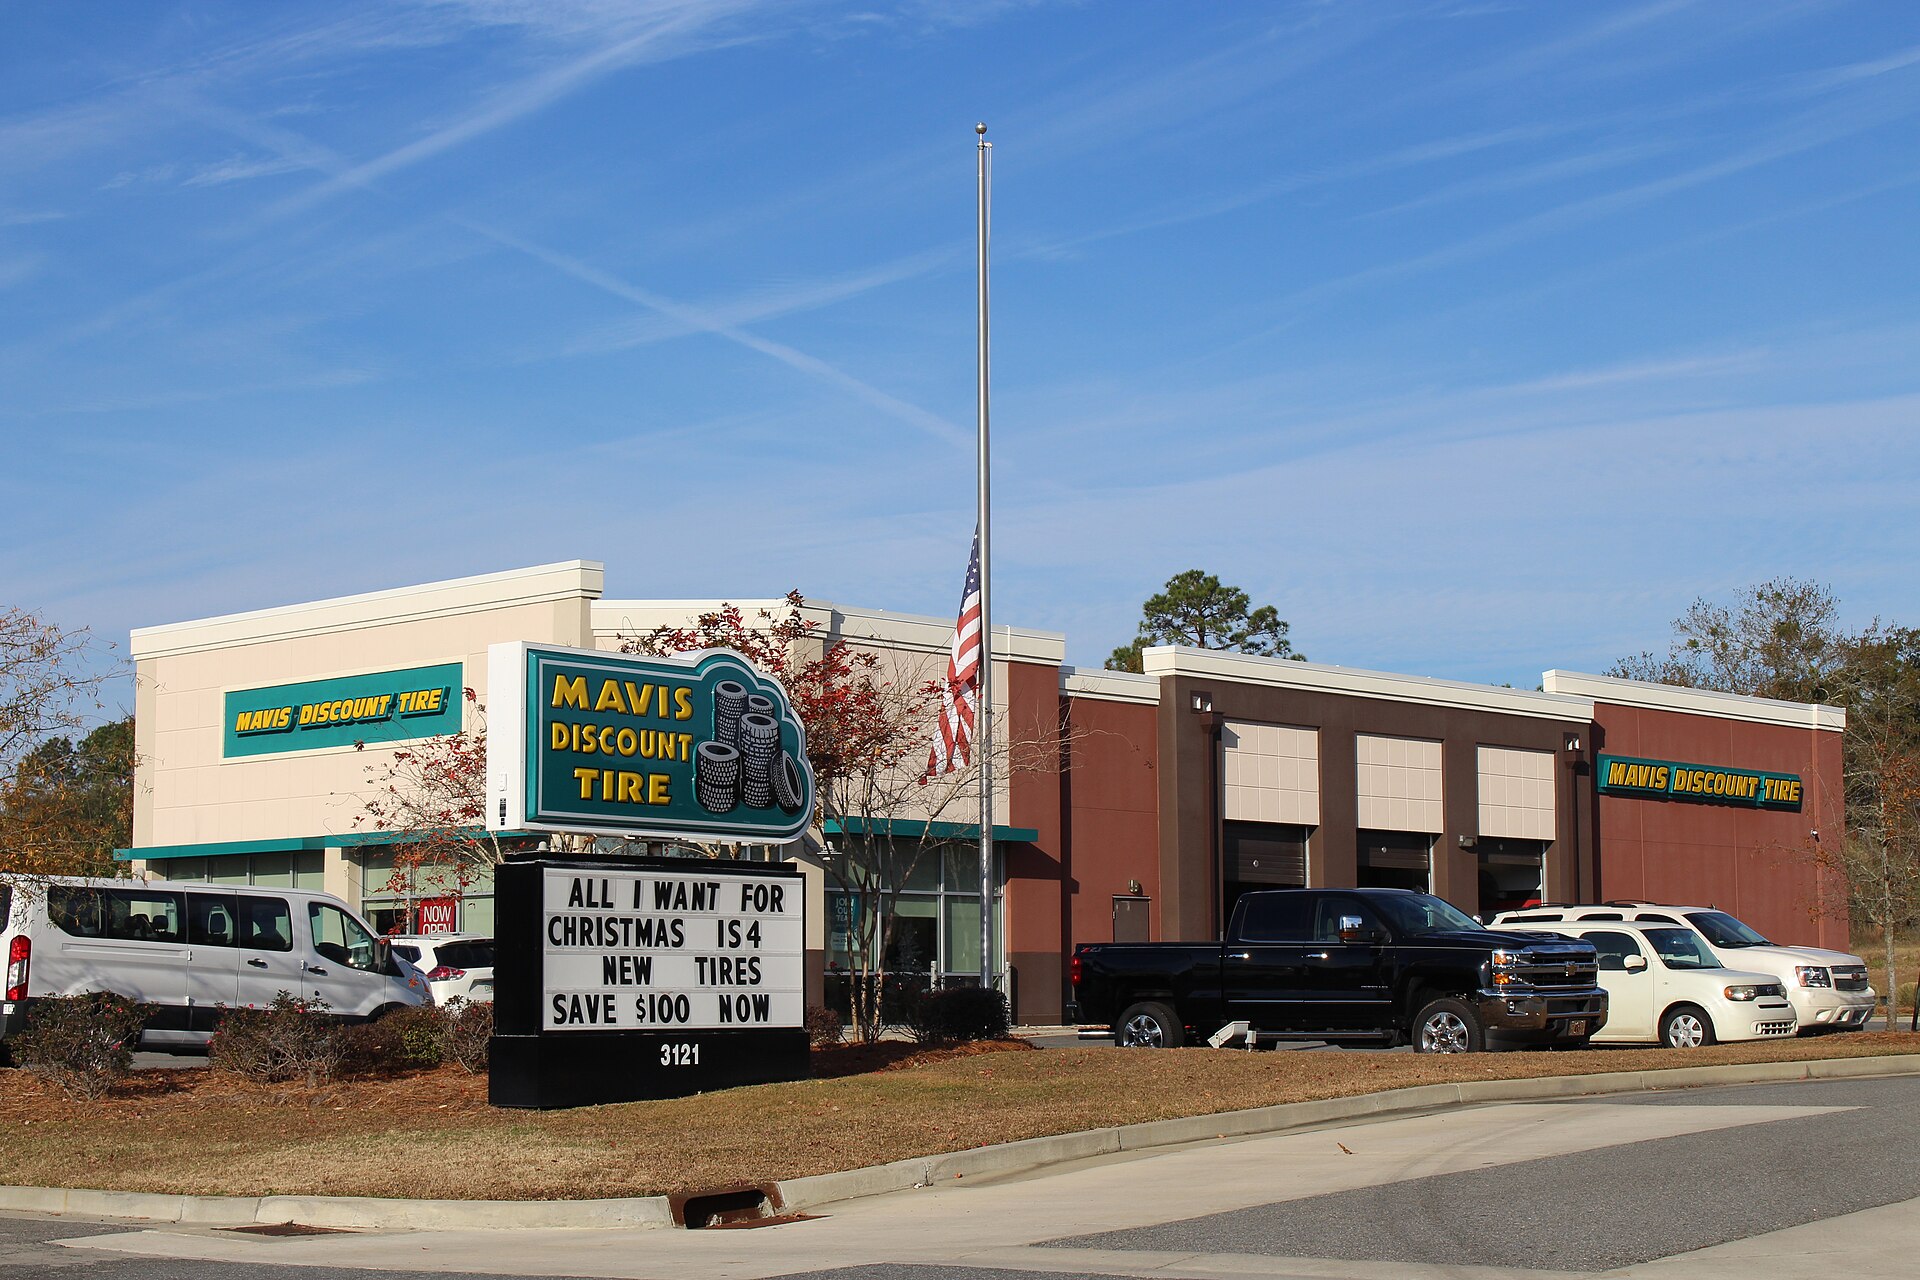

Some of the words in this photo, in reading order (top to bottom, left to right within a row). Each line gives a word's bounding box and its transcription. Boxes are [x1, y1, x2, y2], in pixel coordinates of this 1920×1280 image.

[235, 706, 292, 732] MAVIS
[299, 694, 391, 725] DISCOUNT
[399, 688, 442, 713] TIRE
[552, 674, 692, 720] MAVIS
[551, 722, 692, 762] DISCOUNT
[574, 767, 671, 804] TIRE
[1608, 762, 1668, 790] MAVIS
[1673, 769, 1759, 798] DISCOUNT
[1764, 778, 1801, 802] TIRE
[568, 878, 614, 909] ALL
[633, 880, 641, 909] I
[654, 881, 720, 911] WANT
[741, 884, 784, 912] FOR
[423, 905, 451, 922] NOW
[547, 915, 685, 948] CHRISTMAS
[603, 955, 652, 985] NEW
[694, 956, 762, 985] TIRES
[553, 994, 617, 1024] SAVE
[635, 993, 690, 1023] $100
[719, 994, 770, 1022] NOW
[660, 1043, 699, 1066] 3121
